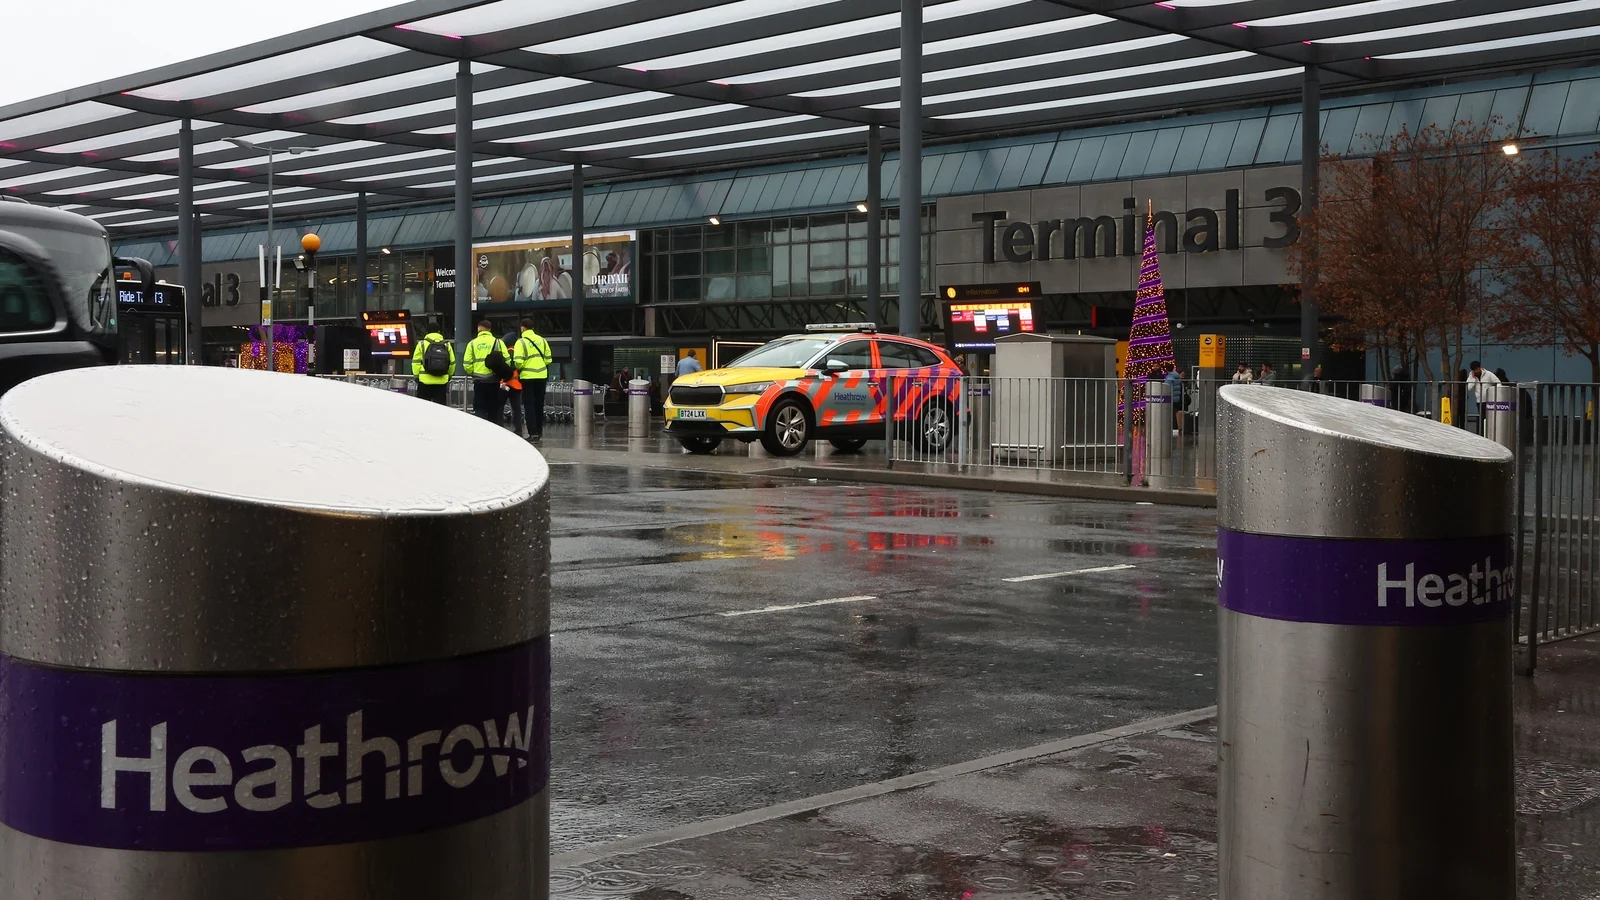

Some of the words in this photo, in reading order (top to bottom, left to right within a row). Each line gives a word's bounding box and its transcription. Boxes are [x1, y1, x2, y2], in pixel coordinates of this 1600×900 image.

[971, 188, 1240, 264] Terminal
[1263, 186, 1302, 249] 3
[435, 268, 456, 277] Welcom
[435, 280, 456, 289] Termin
[591, 274, 628, 285] DIRIYAH
[119, 290, 135, 303] Ride
[226, 273, 241, 307] 3
[834, 392, 866, 401] Heathrow
[1377, 556, 1515, 607] Heathro
[100, 705, 535, 813] Heathrow
